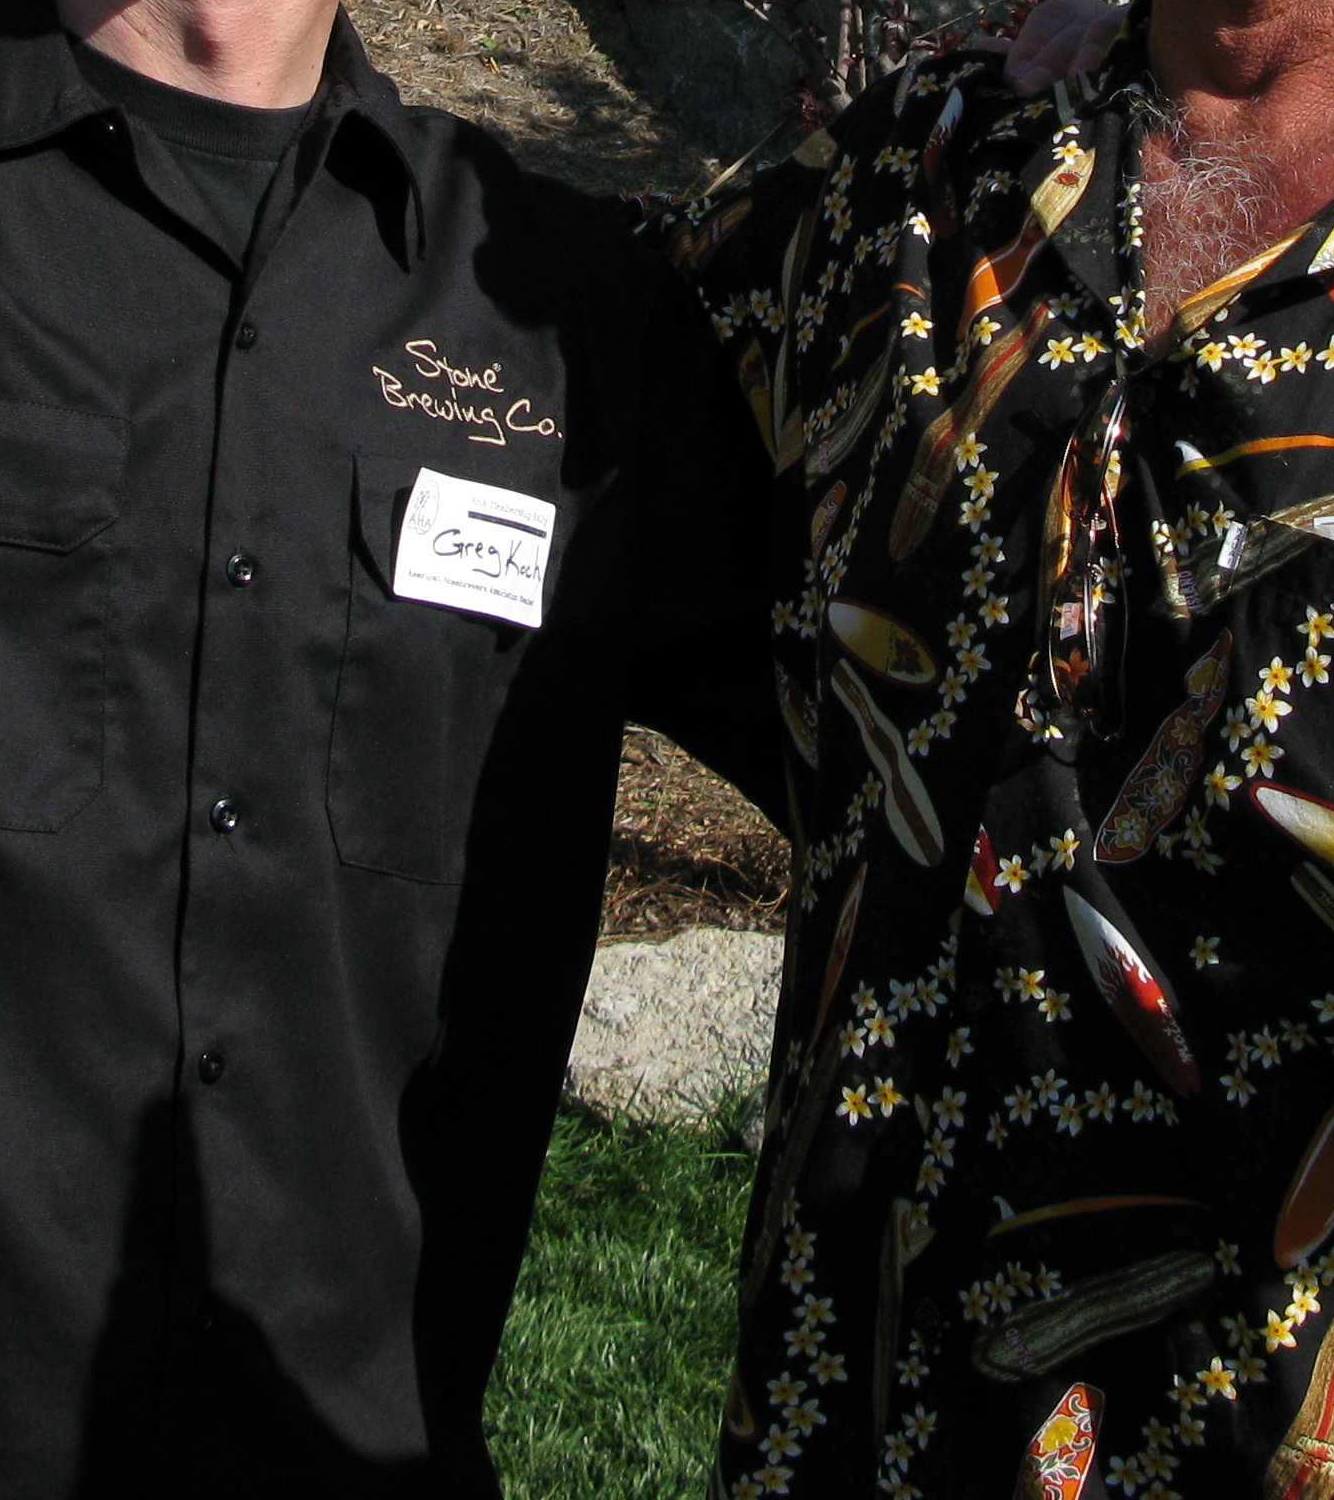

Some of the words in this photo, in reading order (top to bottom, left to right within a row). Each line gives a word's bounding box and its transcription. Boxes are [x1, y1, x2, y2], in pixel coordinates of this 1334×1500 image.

[405, 338, 506, 394] Stone
[372, 364, 507, 446] Brewing
[505, 398, 563, 439] Co.
[433, 528, 502, 578] Greg
[505, 539, 542, 582] Koch
